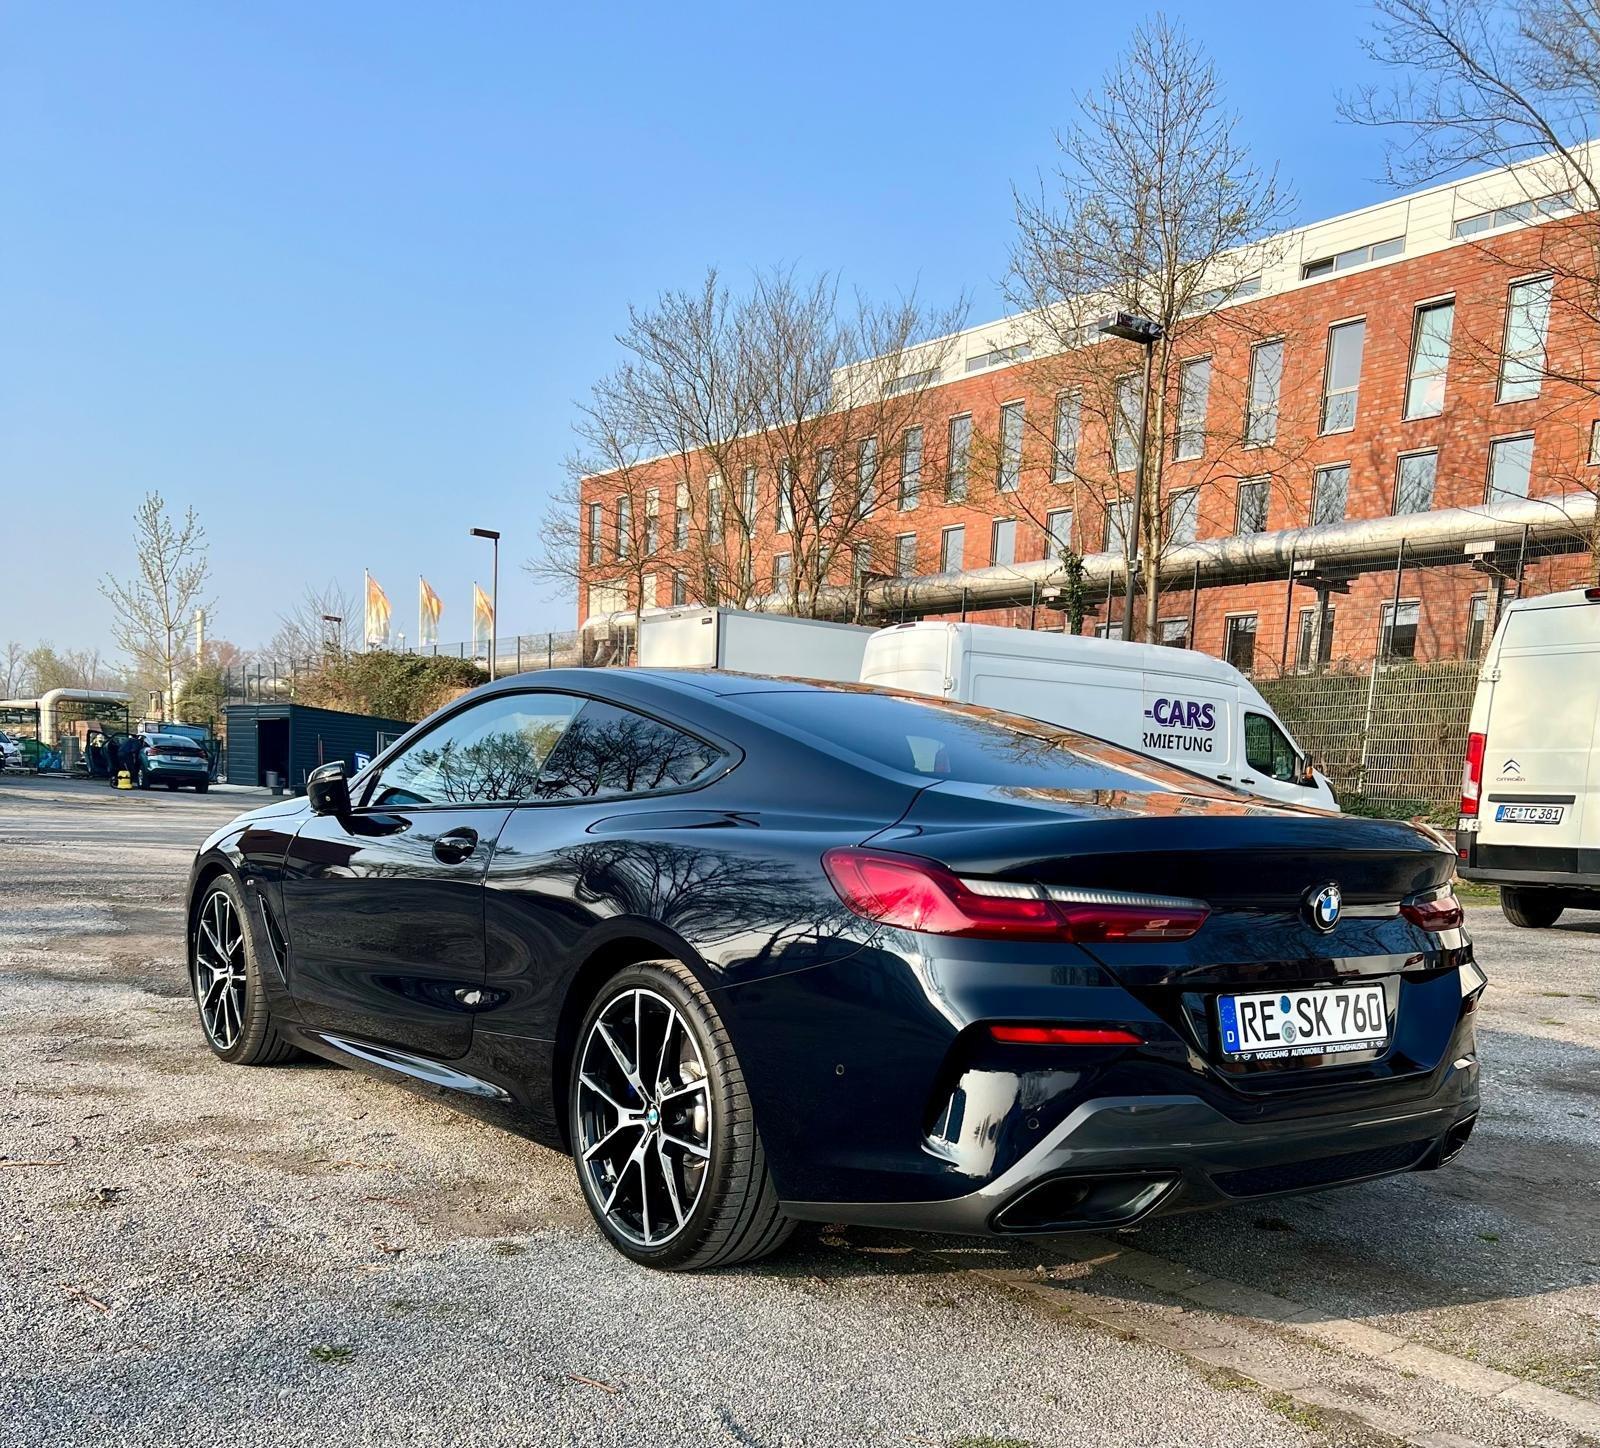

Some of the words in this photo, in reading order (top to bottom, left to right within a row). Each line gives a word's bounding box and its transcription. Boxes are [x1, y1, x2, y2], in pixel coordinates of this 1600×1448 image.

[1144, 698, 1216, 731] -CARS
[1503, 807, 1518, 818] RE
[1524, 808, 1537, 819] TC
[1538, 808, 1560, 820] 381
[1240, 1000, 1281, 1043] RE
[1296, 995, 1333, 1038] SK
[1335, 993, 1383, 1034] 760
[1226, 1030, 1235, 1043] D
[1255, 1049, 1289, 1060] VOGELSANG
[1290, 1046, 1324, 1057] AUTOMOBILE
